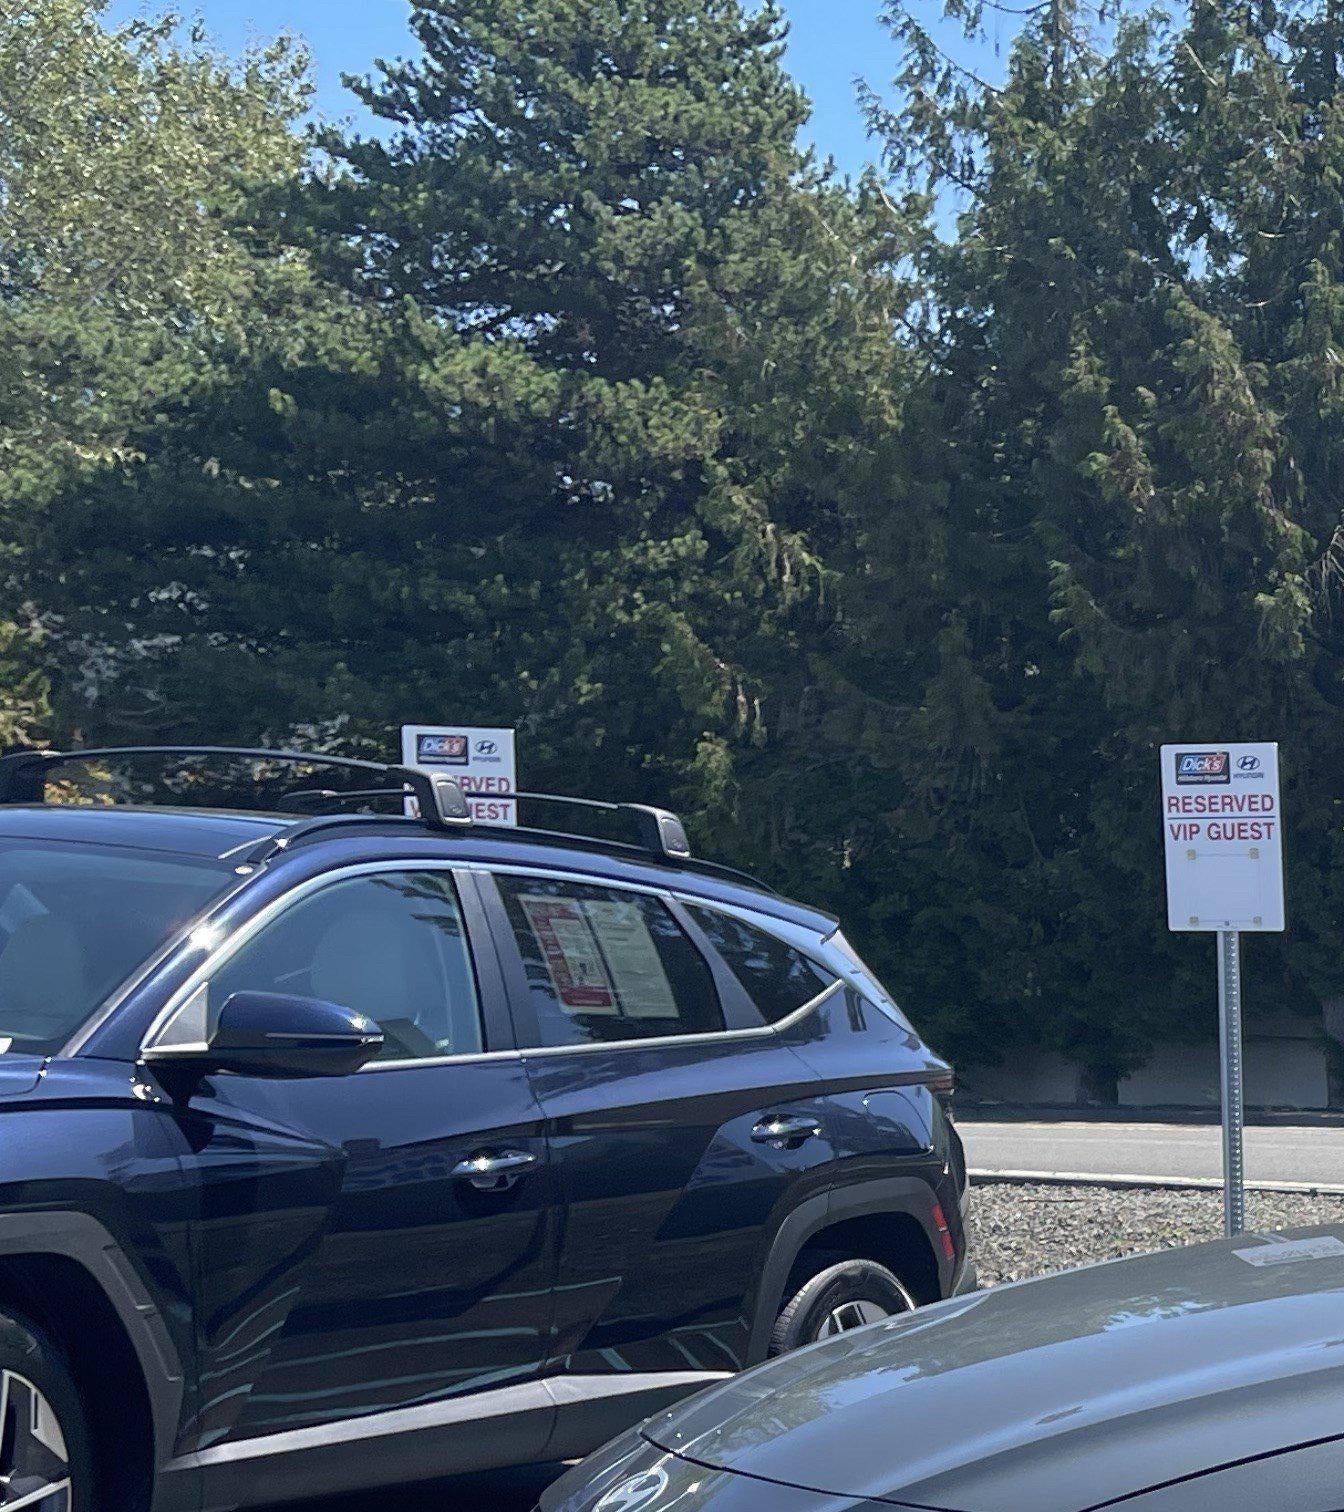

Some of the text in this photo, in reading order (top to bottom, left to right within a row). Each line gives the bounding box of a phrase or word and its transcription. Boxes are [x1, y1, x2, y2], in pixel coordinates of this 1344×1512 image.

[1167, 794, 1275, 813] RESERVED
[1169, 822, 1275, 841] VIP GUEST
